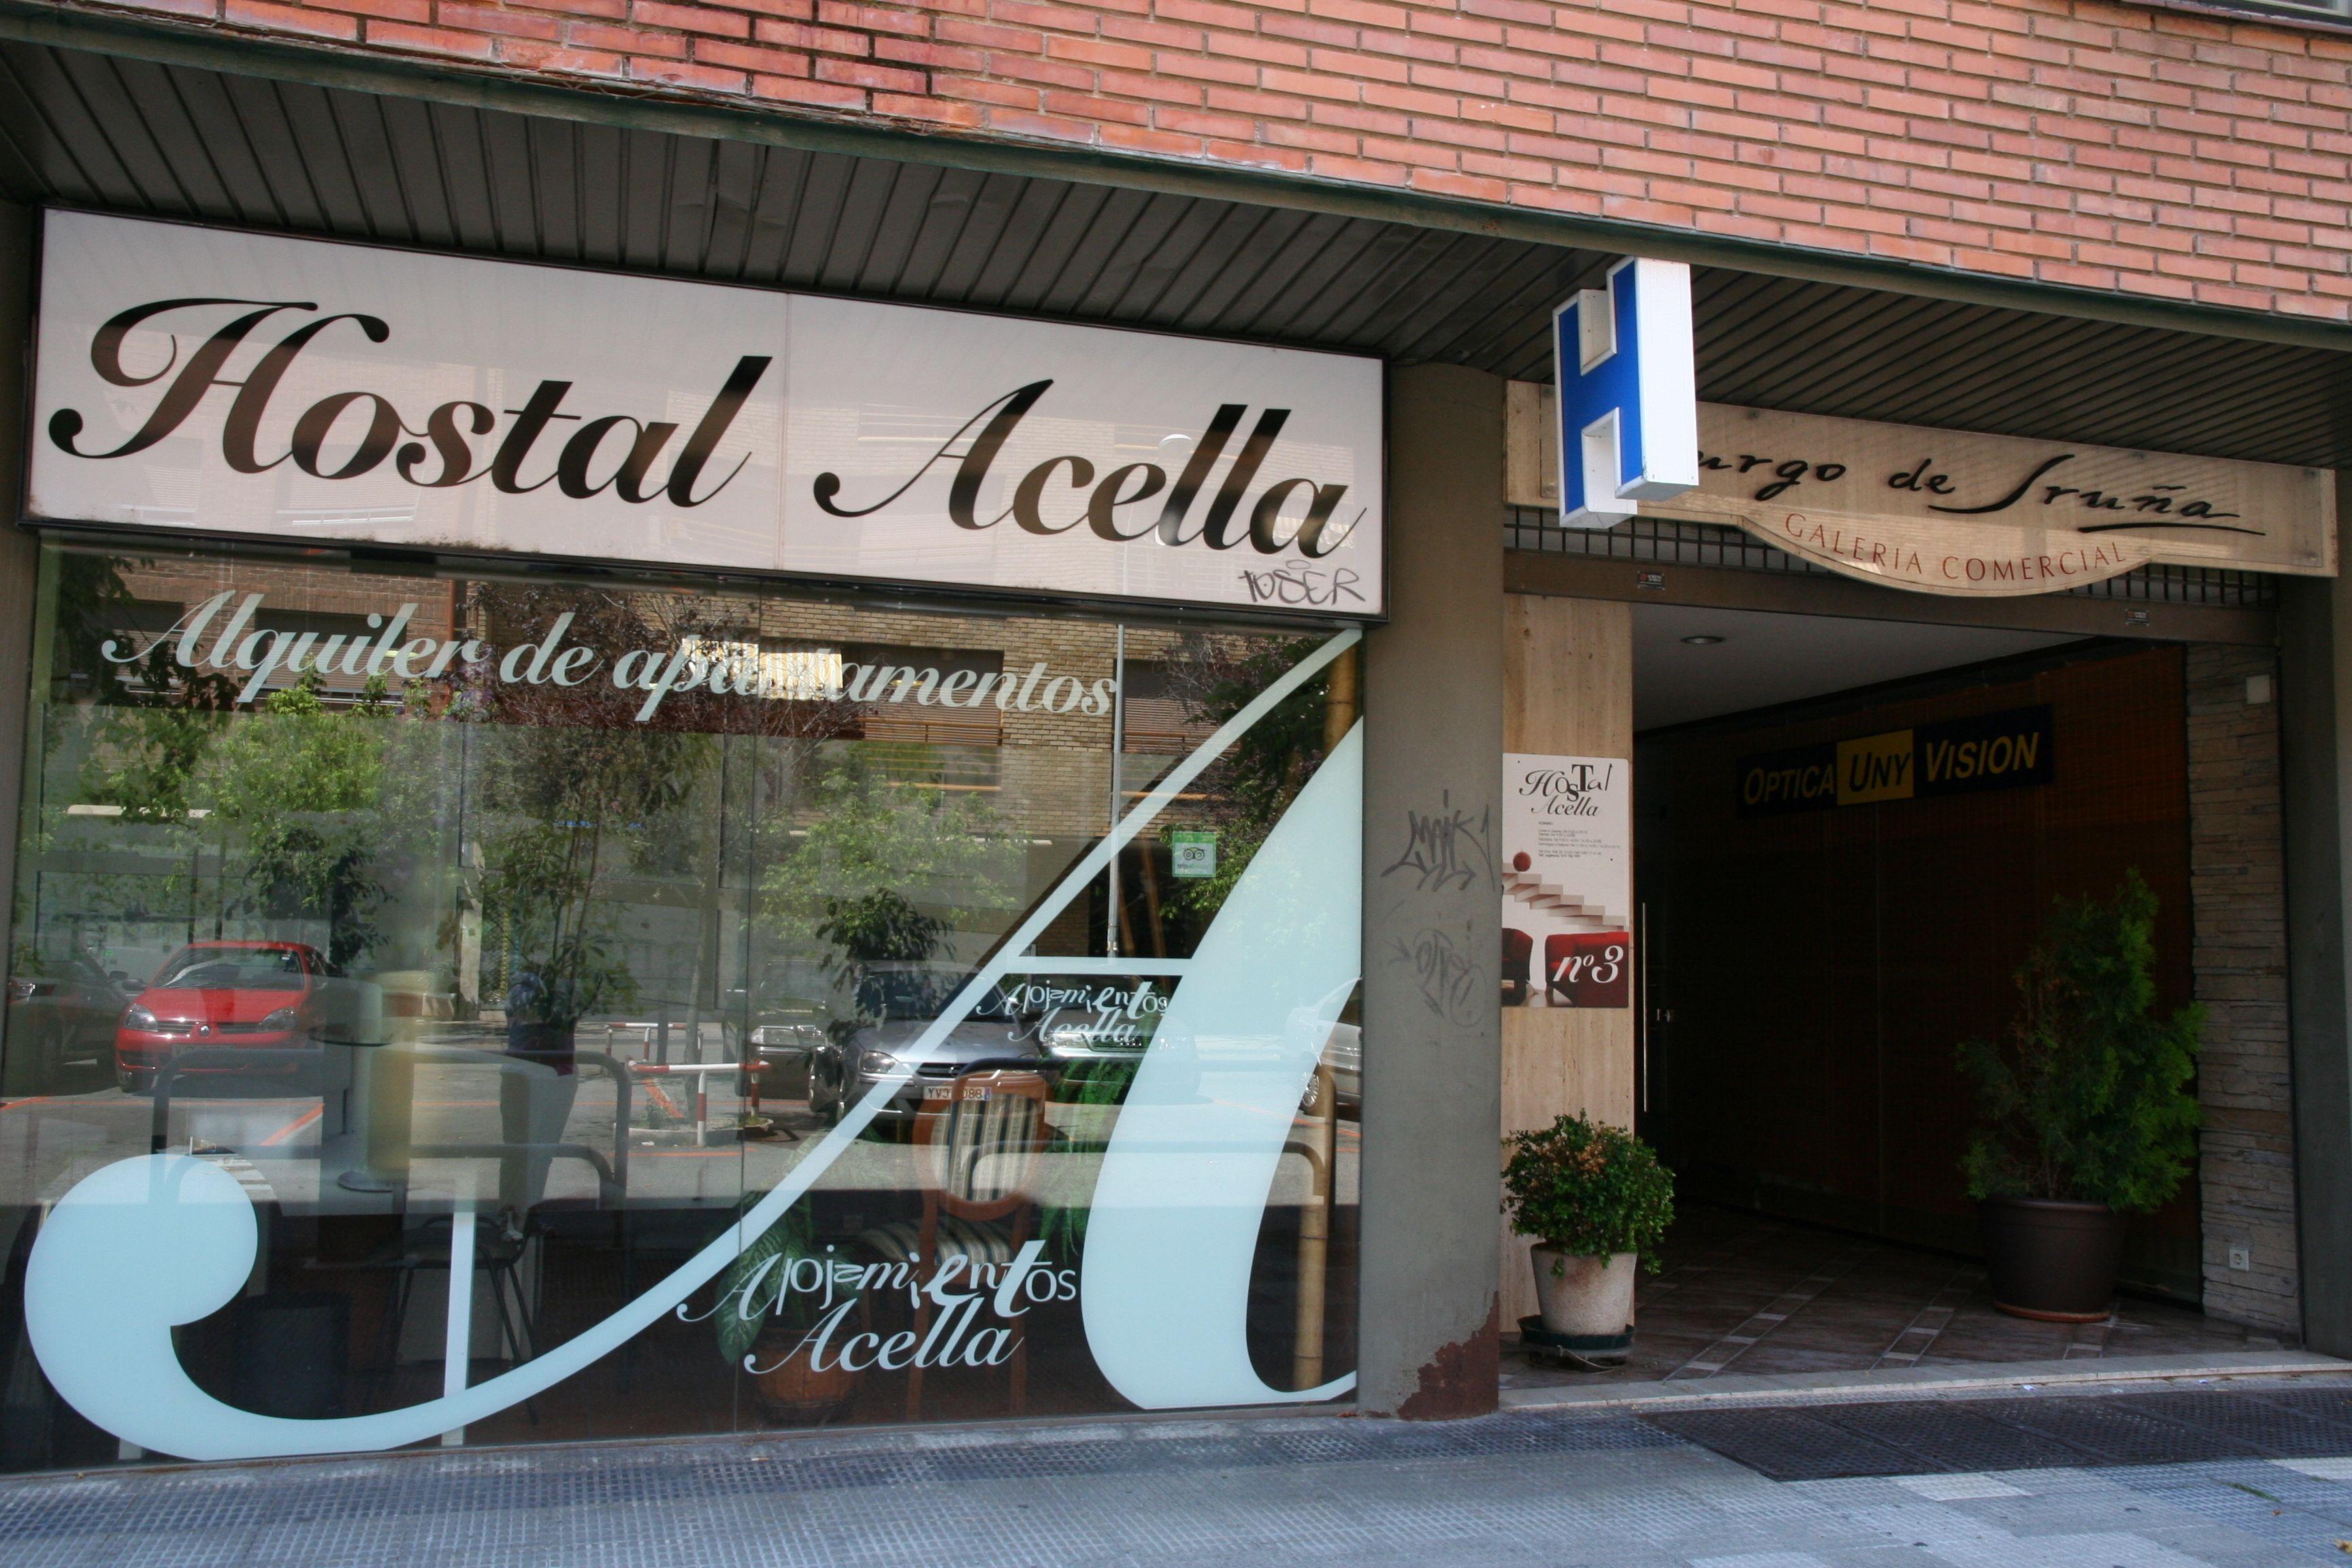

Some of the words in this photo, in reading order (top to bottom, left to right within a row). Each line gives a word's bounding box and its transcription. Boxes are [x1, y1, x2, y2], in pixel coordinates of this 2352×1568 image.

[48, 297, 773, 508] Hostal
[813, 378, 1367, 558] Acella
[1553, 257, 1698, 529] H
[1697, 450, 1847, 502] urgo
[1888, 458, 1955, 494] de
[1785, 512, 1922, 574] GALERIA
[1942, 541, 2126, 581] COMERCIAL
[101, 589, 491, 704] Alquiler
[500, 612, 605, 686] de
[612, 634, 1117, 722] apaamentos
[1743, 764, 1835, 805] OPTICA
[1925, 732, 2040, 782] VISION
[1531, 795, 1603, 817] Acella
[1007, 1006, 1143, 1043] Acella
[743, 1296, 1024, 1375] Acella
